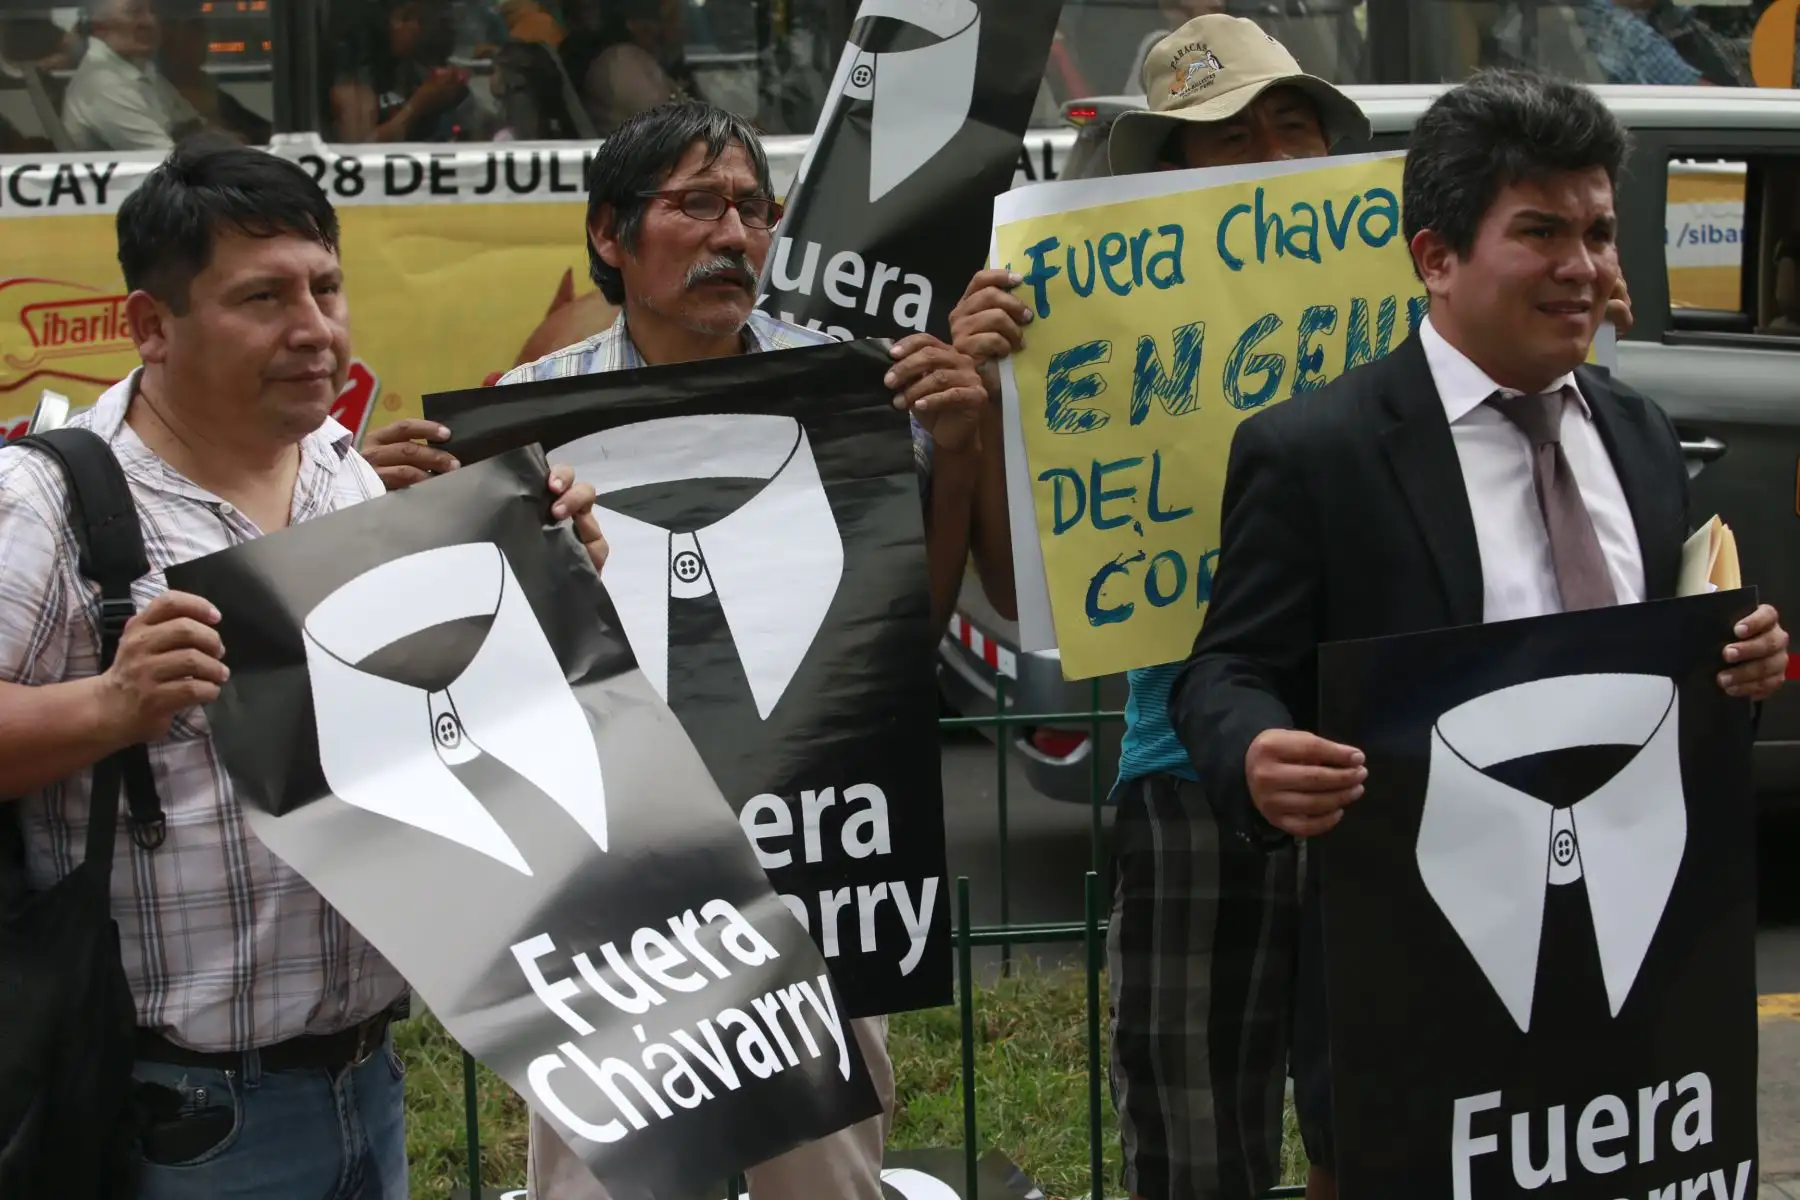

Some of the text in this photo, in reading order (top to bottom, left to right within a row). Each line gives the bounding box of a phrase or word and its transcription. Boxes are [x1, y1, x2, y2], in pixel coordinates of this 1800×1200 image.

[1170, 43, 1208, 70] PARACAS
[0, 162, 118, 207] CAY
[384, 153, 459, 196] DE
[1024, 223, 1185, 319] Fuera
[1038, 449, 1194, 536] DEL
[510, 898, 780, 1036] Fuera
[526, 974, 851, 1143] Chávarry
[1452, 1071, 1713, 1200] Fuera
